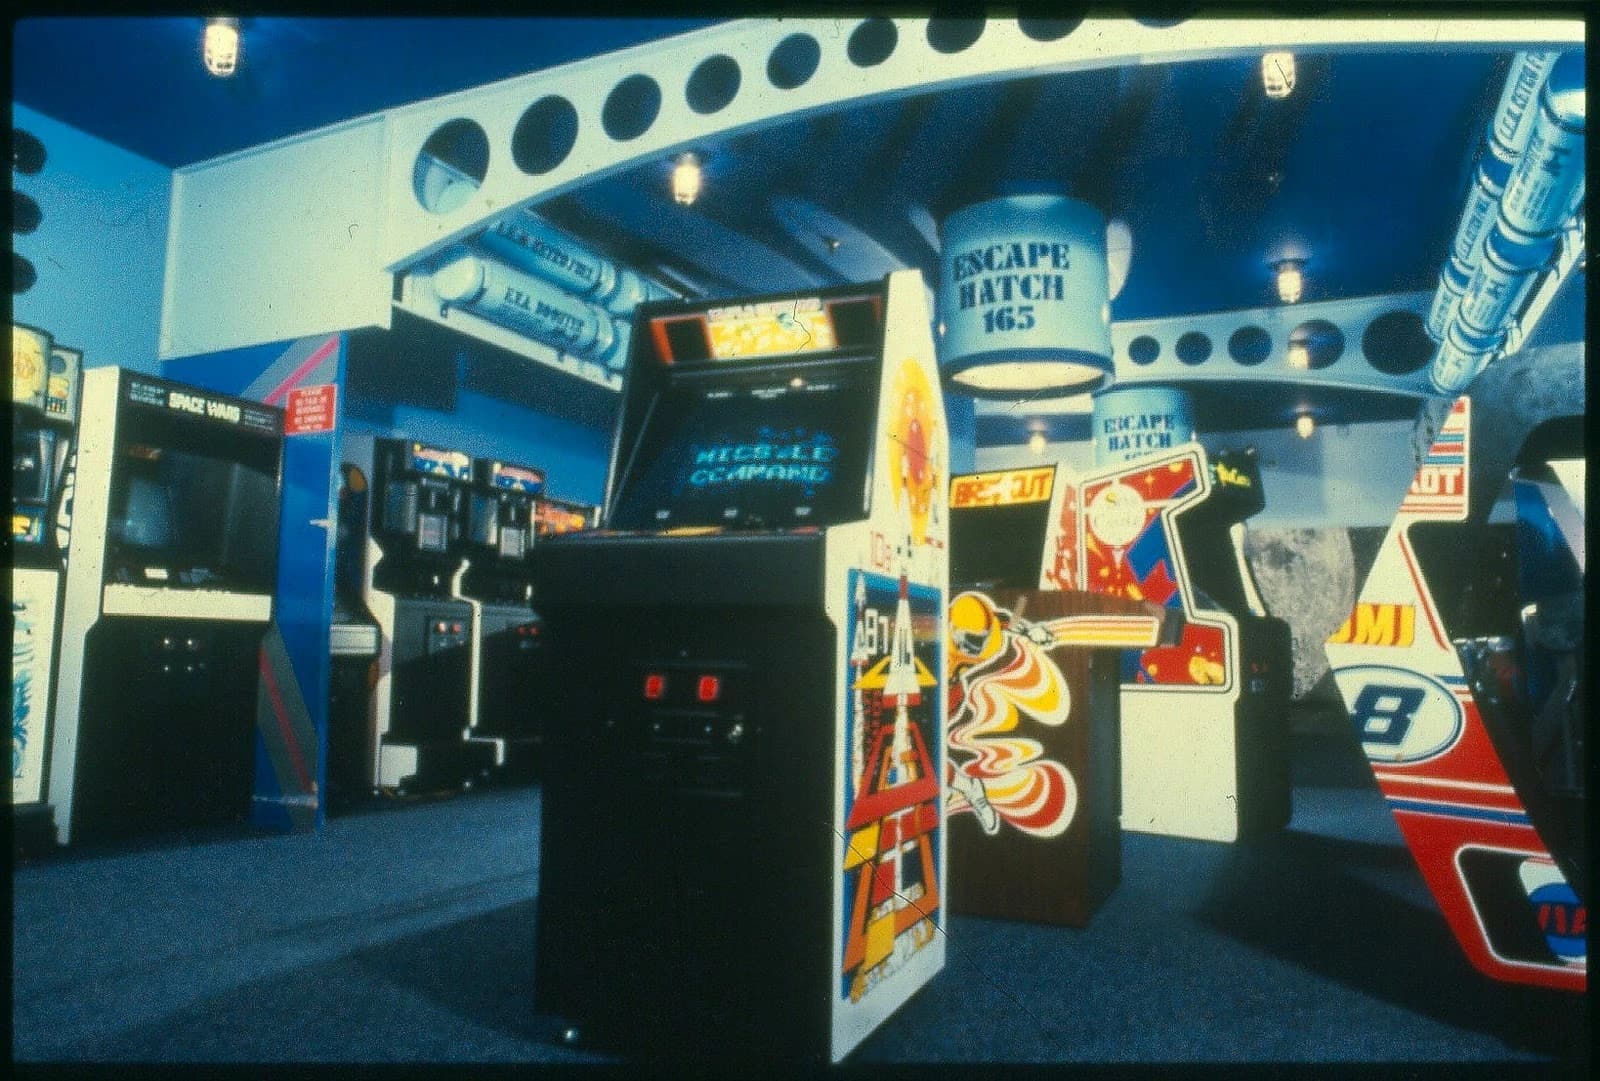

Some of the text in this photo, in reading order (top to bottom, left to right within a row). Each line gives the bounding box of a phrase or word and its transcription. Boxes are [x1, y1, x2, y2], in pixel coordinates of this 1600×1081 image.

[952, 242, 1070, 282] ESCAPE
[959, 274, 1064, 310] HATCH
[984, 306, 1036, 334] 165
[168, 391, 205, 415] SPACE
[206, 399, 241, 424] WARS
[1104, 414, 1175, 434] ESCAPE
[1109, 431, 1171, 451] HATCH
[688, 464, 833, 486] COMMAND
[1409, 467, 1461, 494] OT
[1355, 684, 1426, 746] 8
